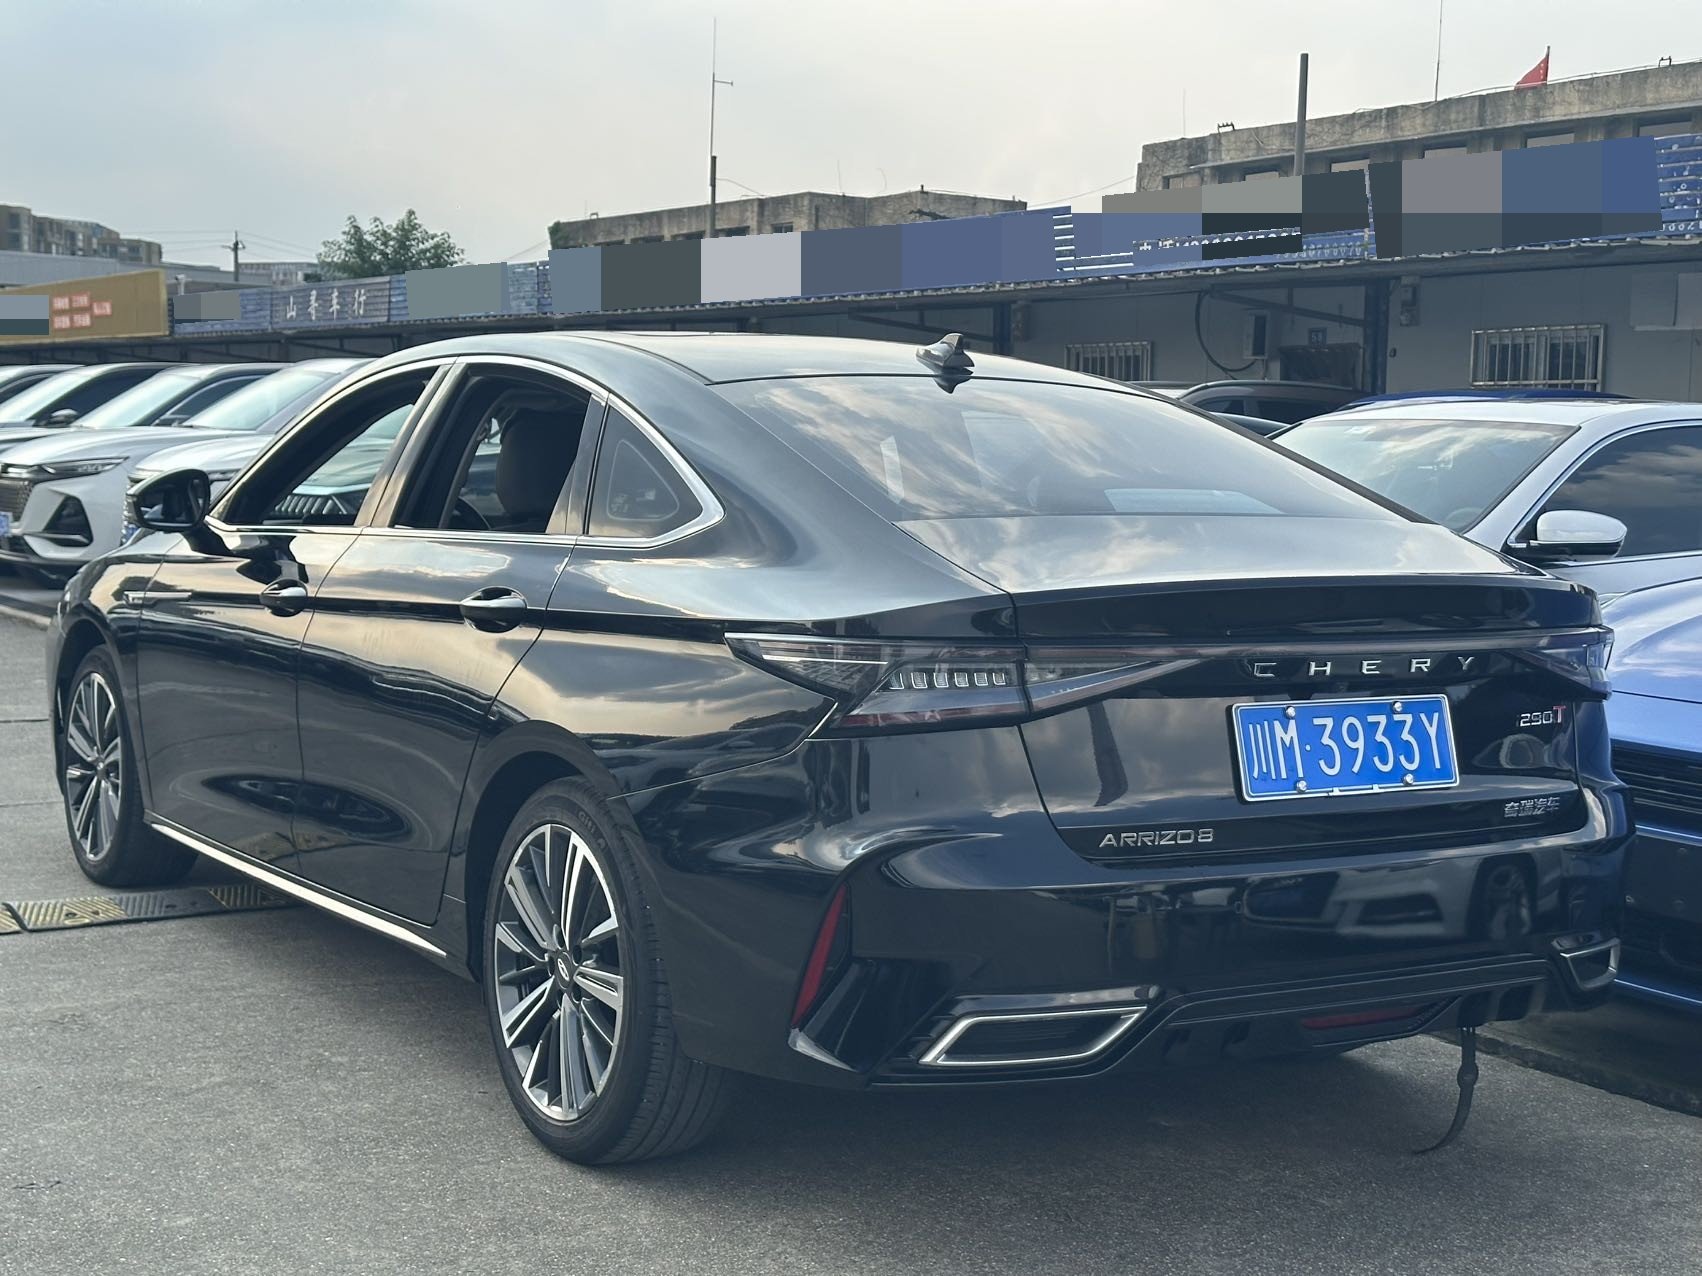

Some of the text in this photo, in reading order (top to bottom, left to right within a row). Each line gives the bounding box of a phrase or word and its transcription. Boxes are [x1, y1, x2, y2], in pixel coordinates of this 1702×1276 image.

[1253, 656, 1475, 678] CHERY
[1248, 711, 1441, 780] 川M·3933Y
[1503, 796, 1561, 818] 奇瑞汽车
